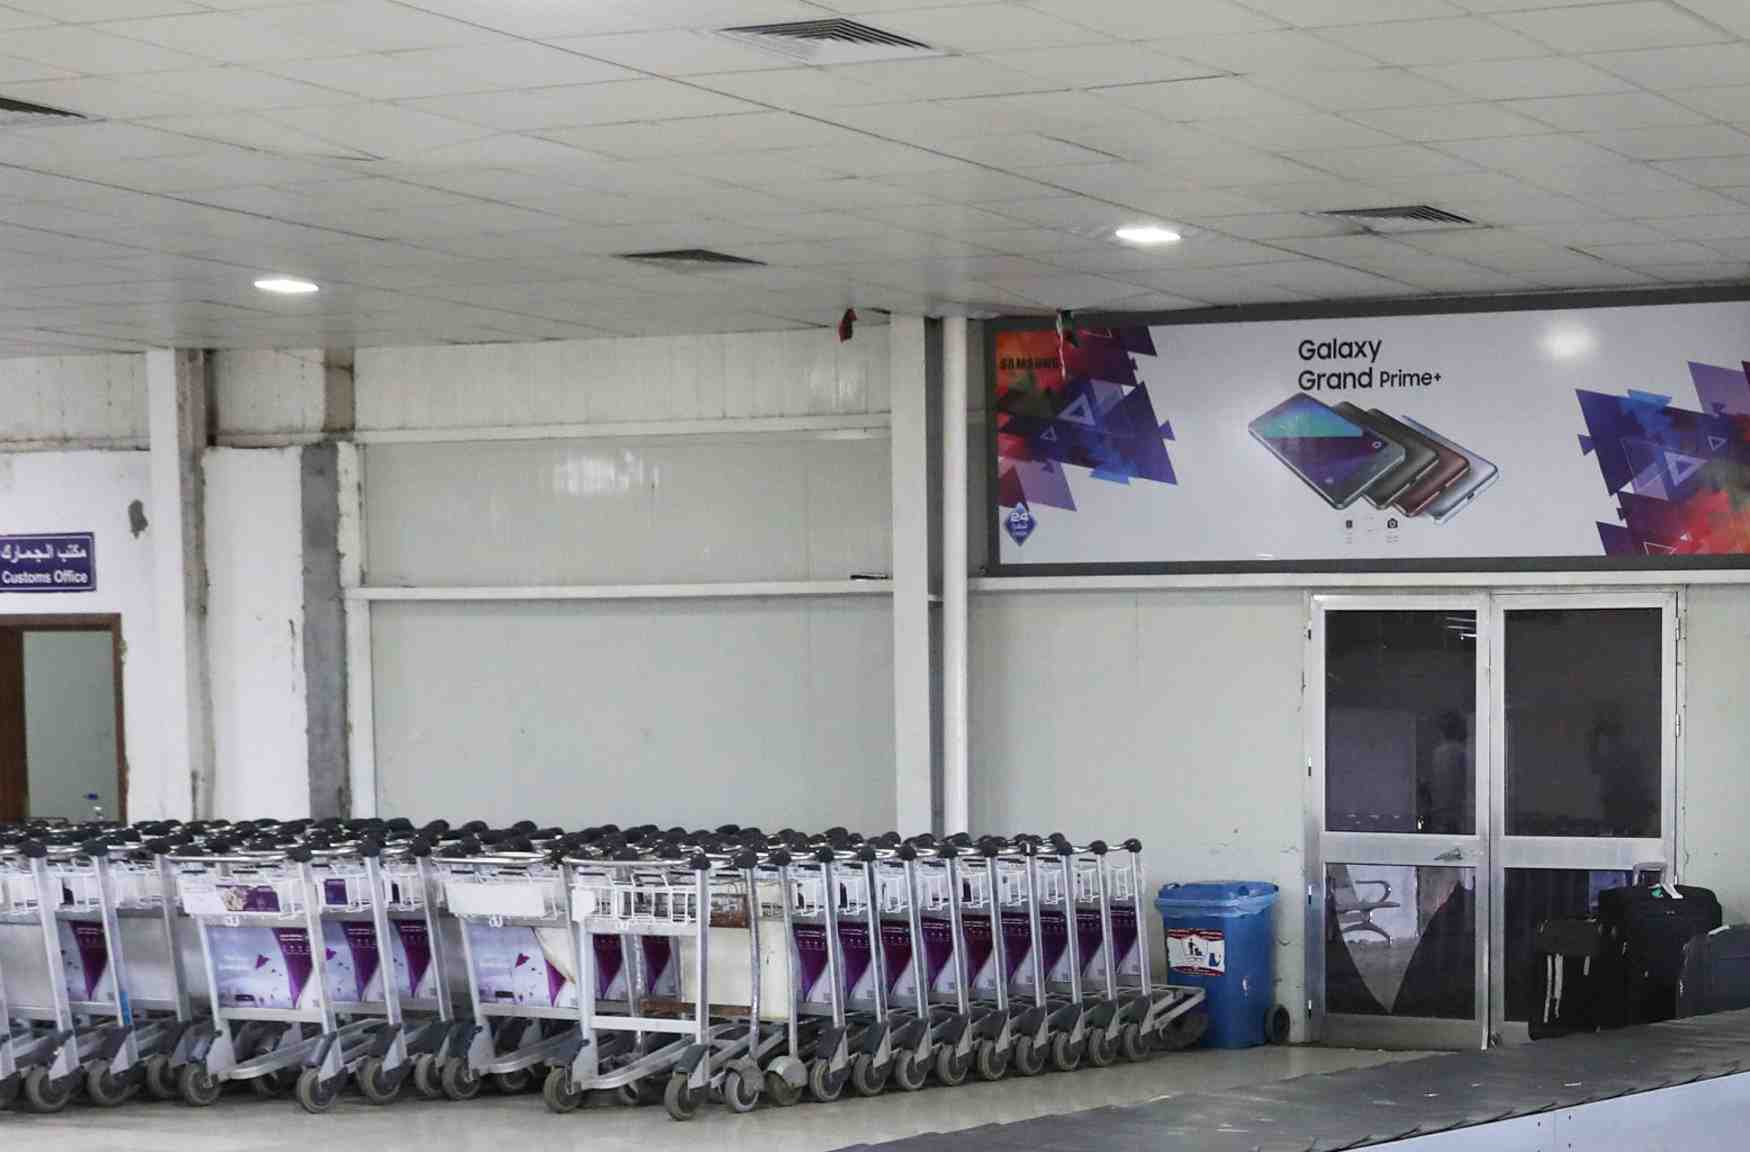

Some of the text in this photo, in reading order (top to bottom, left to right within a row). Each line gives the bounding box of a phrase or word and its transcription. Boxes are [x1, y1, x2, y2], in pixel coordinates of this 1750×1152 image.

[1298, 338, 1382, 364] Galaxy
[1298, 366, 1442, 391] Grand Prime+
[2, 569, 88, 585] Customs Office
